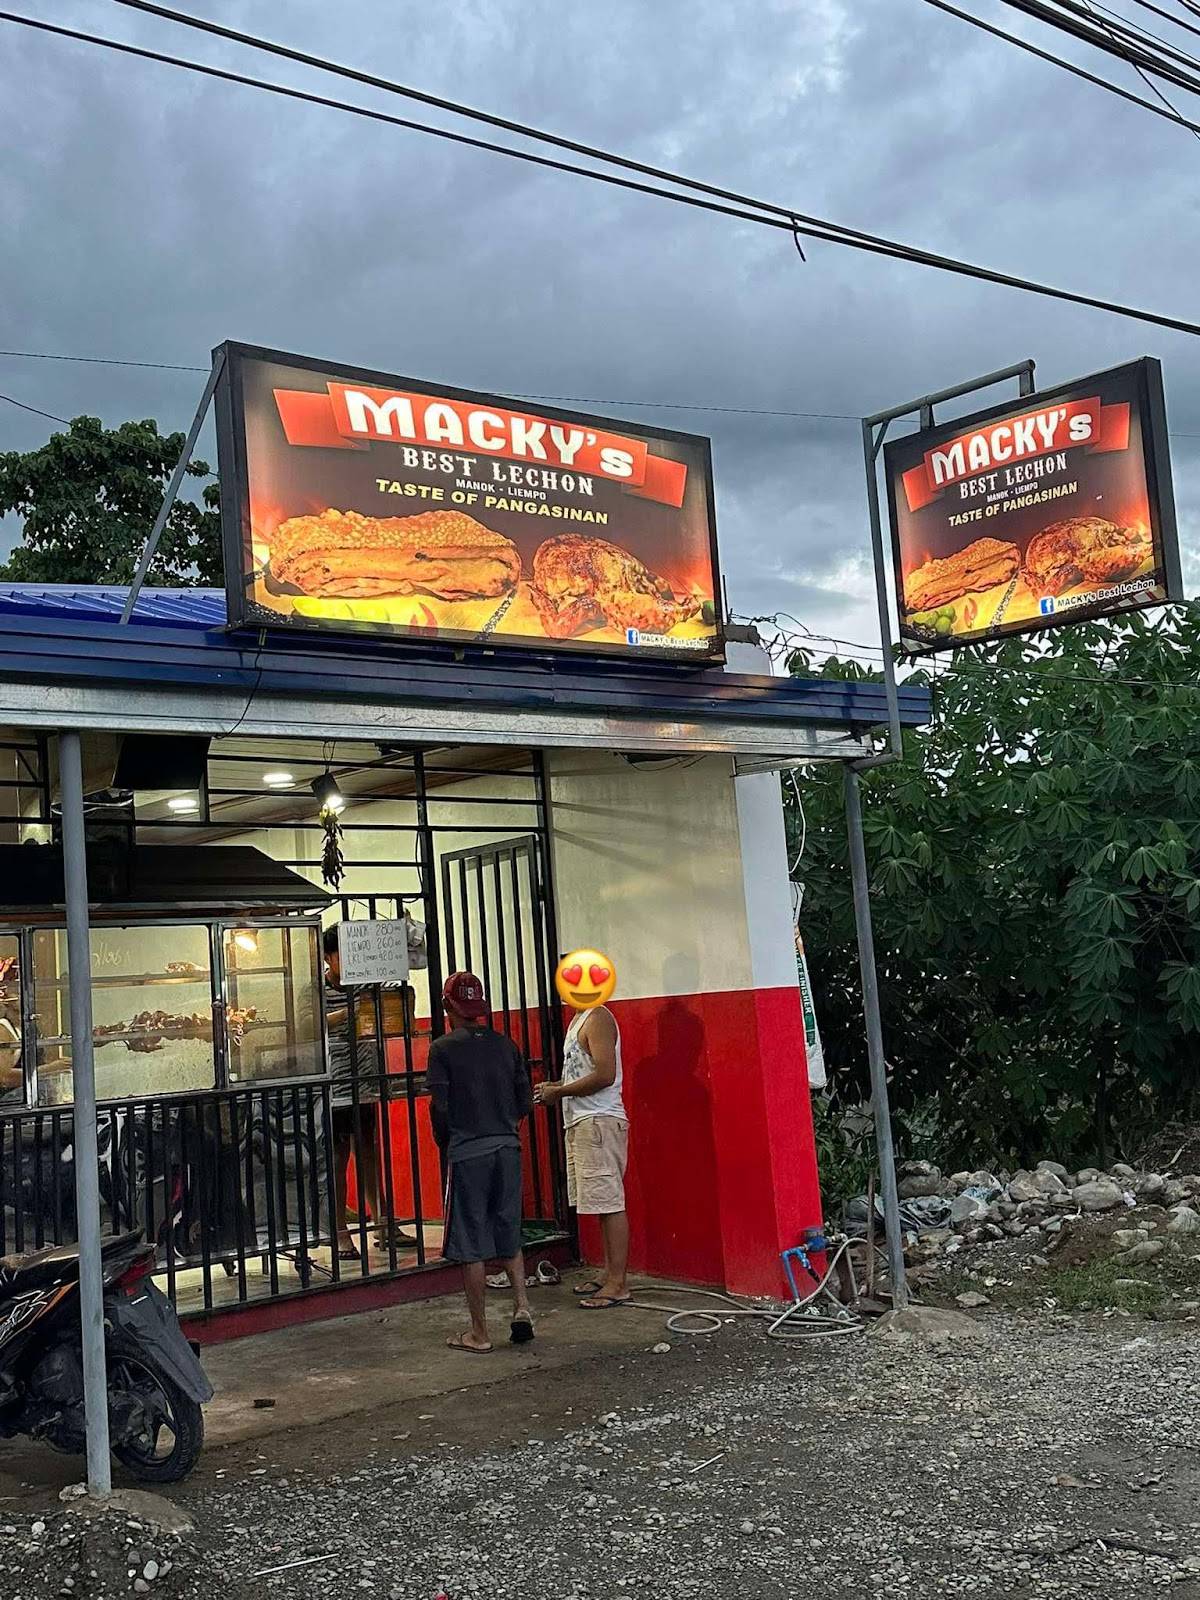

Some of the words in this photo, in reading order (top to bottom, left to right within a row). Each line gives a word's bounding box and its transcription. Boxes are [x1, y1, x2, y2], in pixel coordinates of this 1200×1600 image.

[344, 390, 634, 477] MACKY's
[931, 409, 1092, 485] MACKY's
[402, 447, 477, 477] BEST
[492, 461, 594, 496] LECHON
[455, 478, 495, 493] MANOK
[508, 487, 547, 501] LIEMPO
[960, 473, 998, 499] BEST
[1005, 453, 1067, 486] LECHON
[987, 490, 1009, 502] MANOK
[1015, 482, 1039, 495] LIEMPO
[376, 479, 444, 501] TASTE
[452, 491, 478, 505] OF
[485, 495, 608, 524] PANGASINAN
[949, 509, 982, 527] TASTE
[986, 503, 1000, 516] OF
[1003, 481, 1078, 513] PANGASINAN
[1057, 593, 1095, 606] MACKY's
[1098, 588, 1118, 599] Best
[1121, 580, 1154, 594] Lechon
